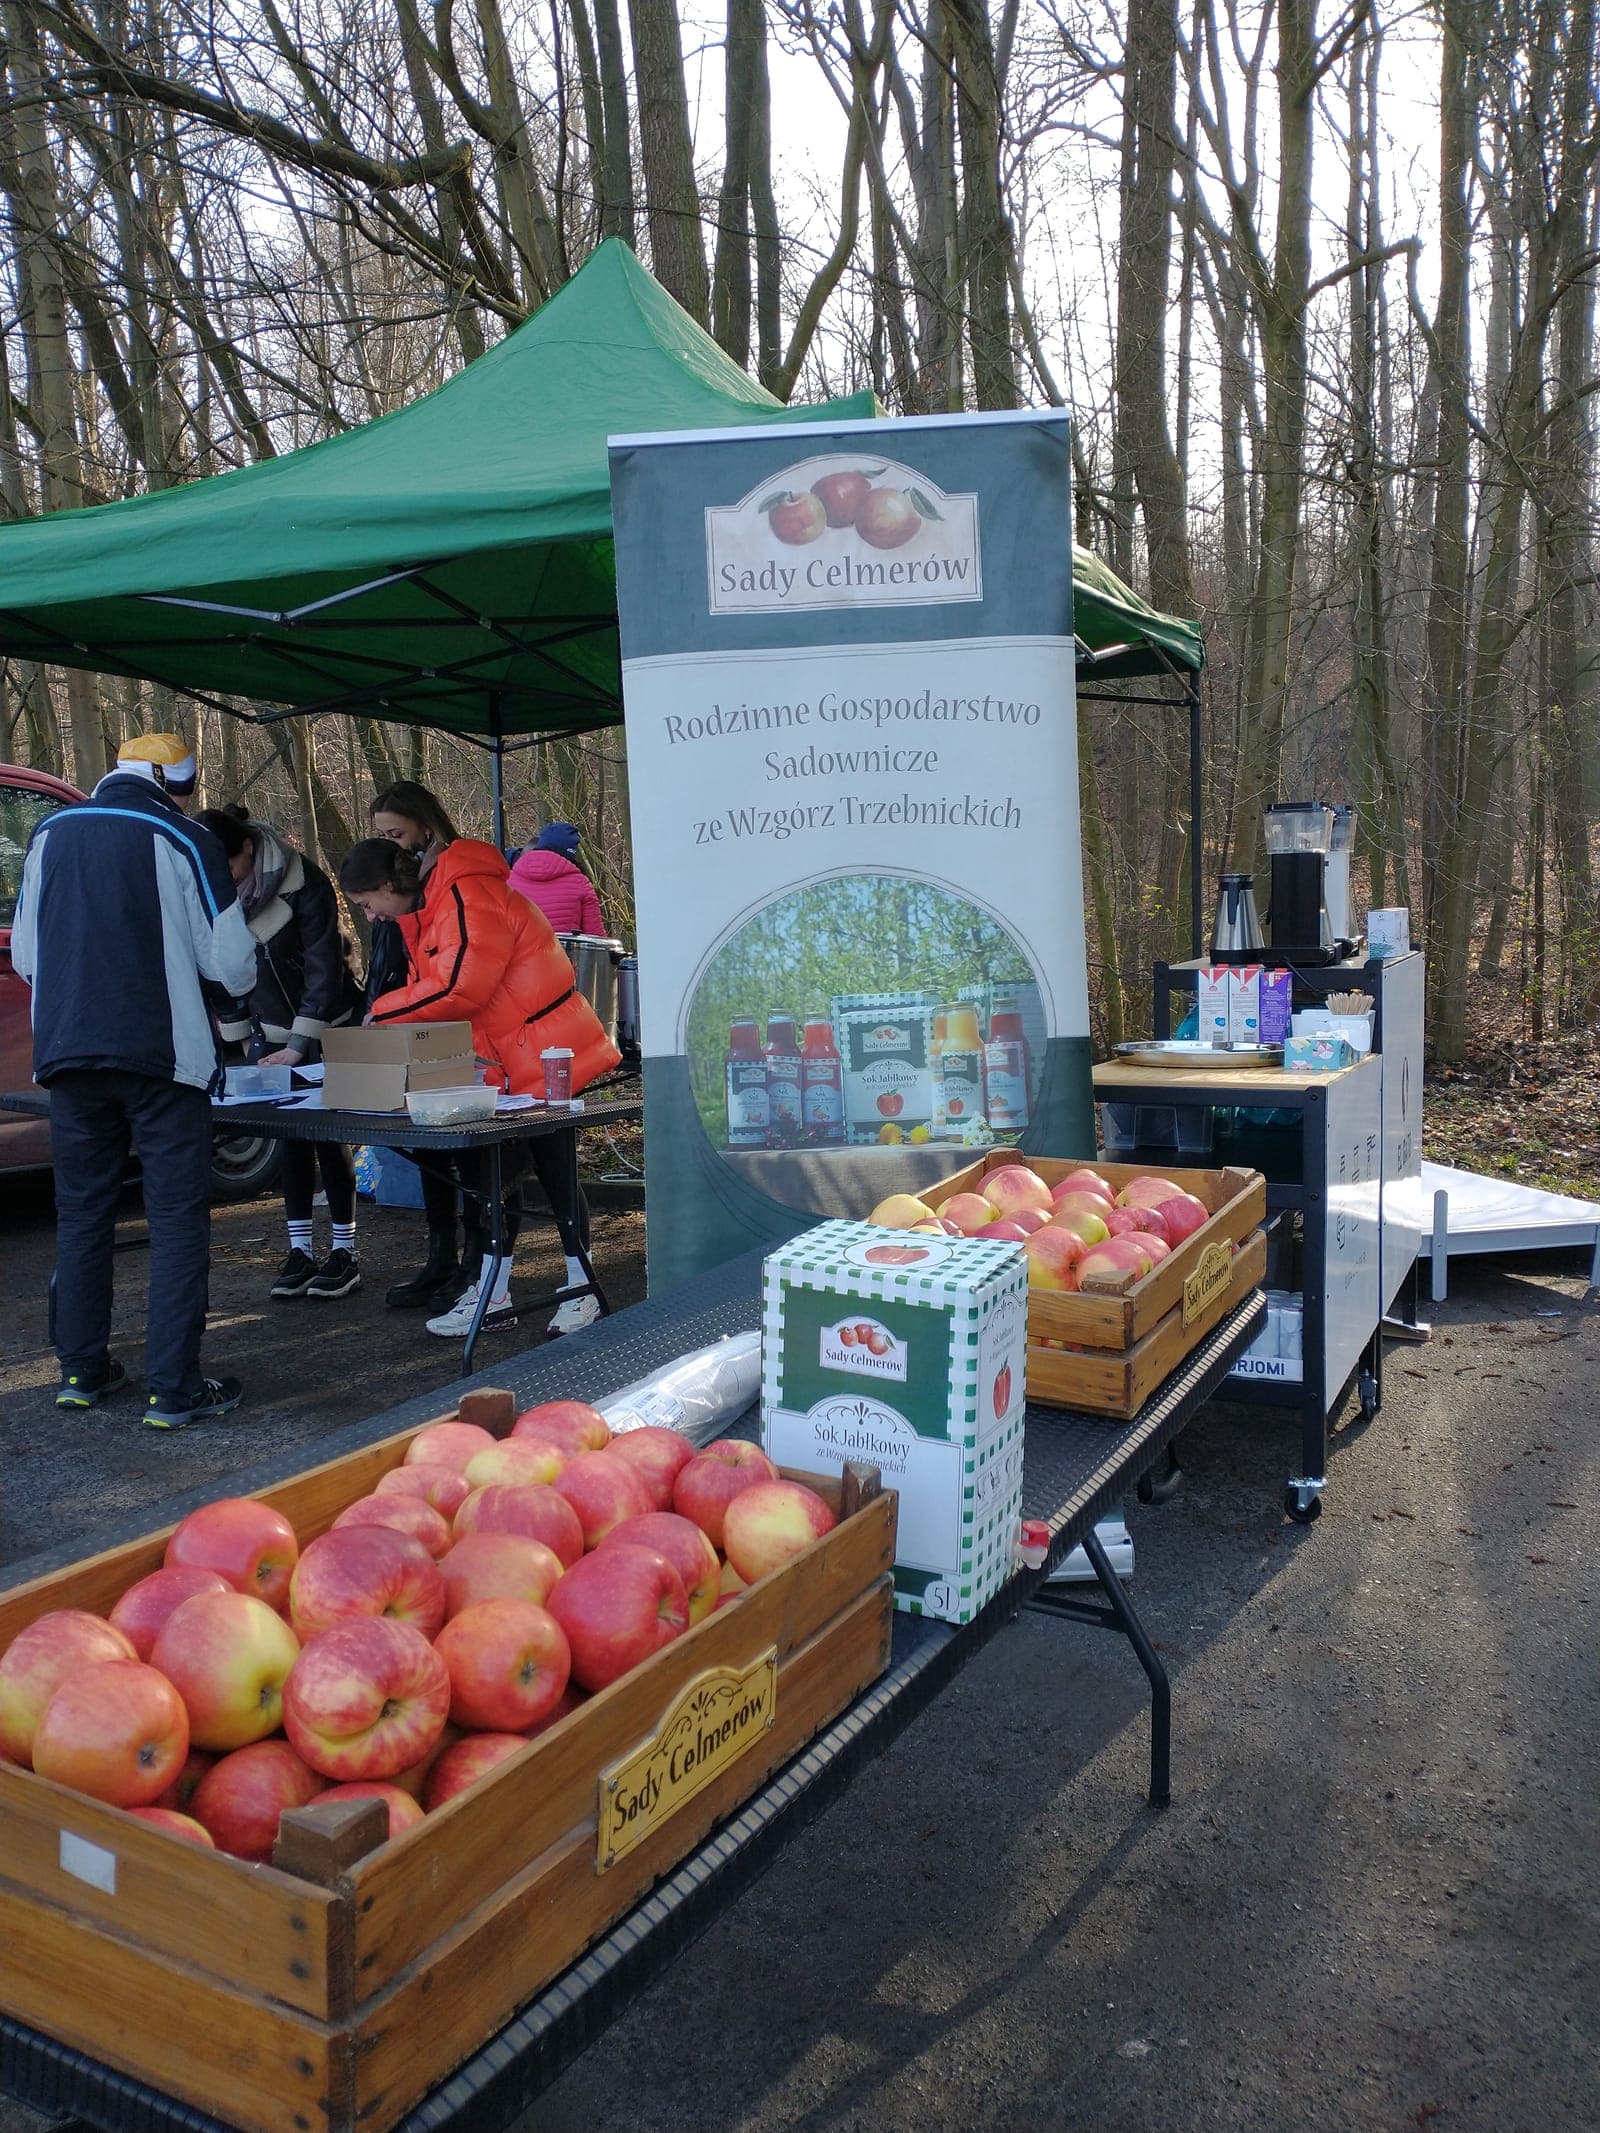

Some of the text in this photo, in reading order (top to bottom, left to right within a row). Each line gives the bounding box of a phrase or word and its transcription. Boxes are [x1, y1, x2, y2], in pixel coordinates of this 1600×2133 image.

[720, 553, 970, 597] Sady Celmerów
[664, 690, 1041, 745] Rodzinne Gospodarstwo
[765, 744, 938, 781] Sadownicze
[694, 794, 1022, 845] ze Wzgórz Trzebnickich
[825, 1348, 902, 1372] Sady Celmerów
[814, 1423, 910, 1461] Sok Jabłkowy
[816, 1447, 824, 1457] ze
[934, 1586, 950, 1611] 5l
[614, 1689, 767, 1834] Sady Celmerów
